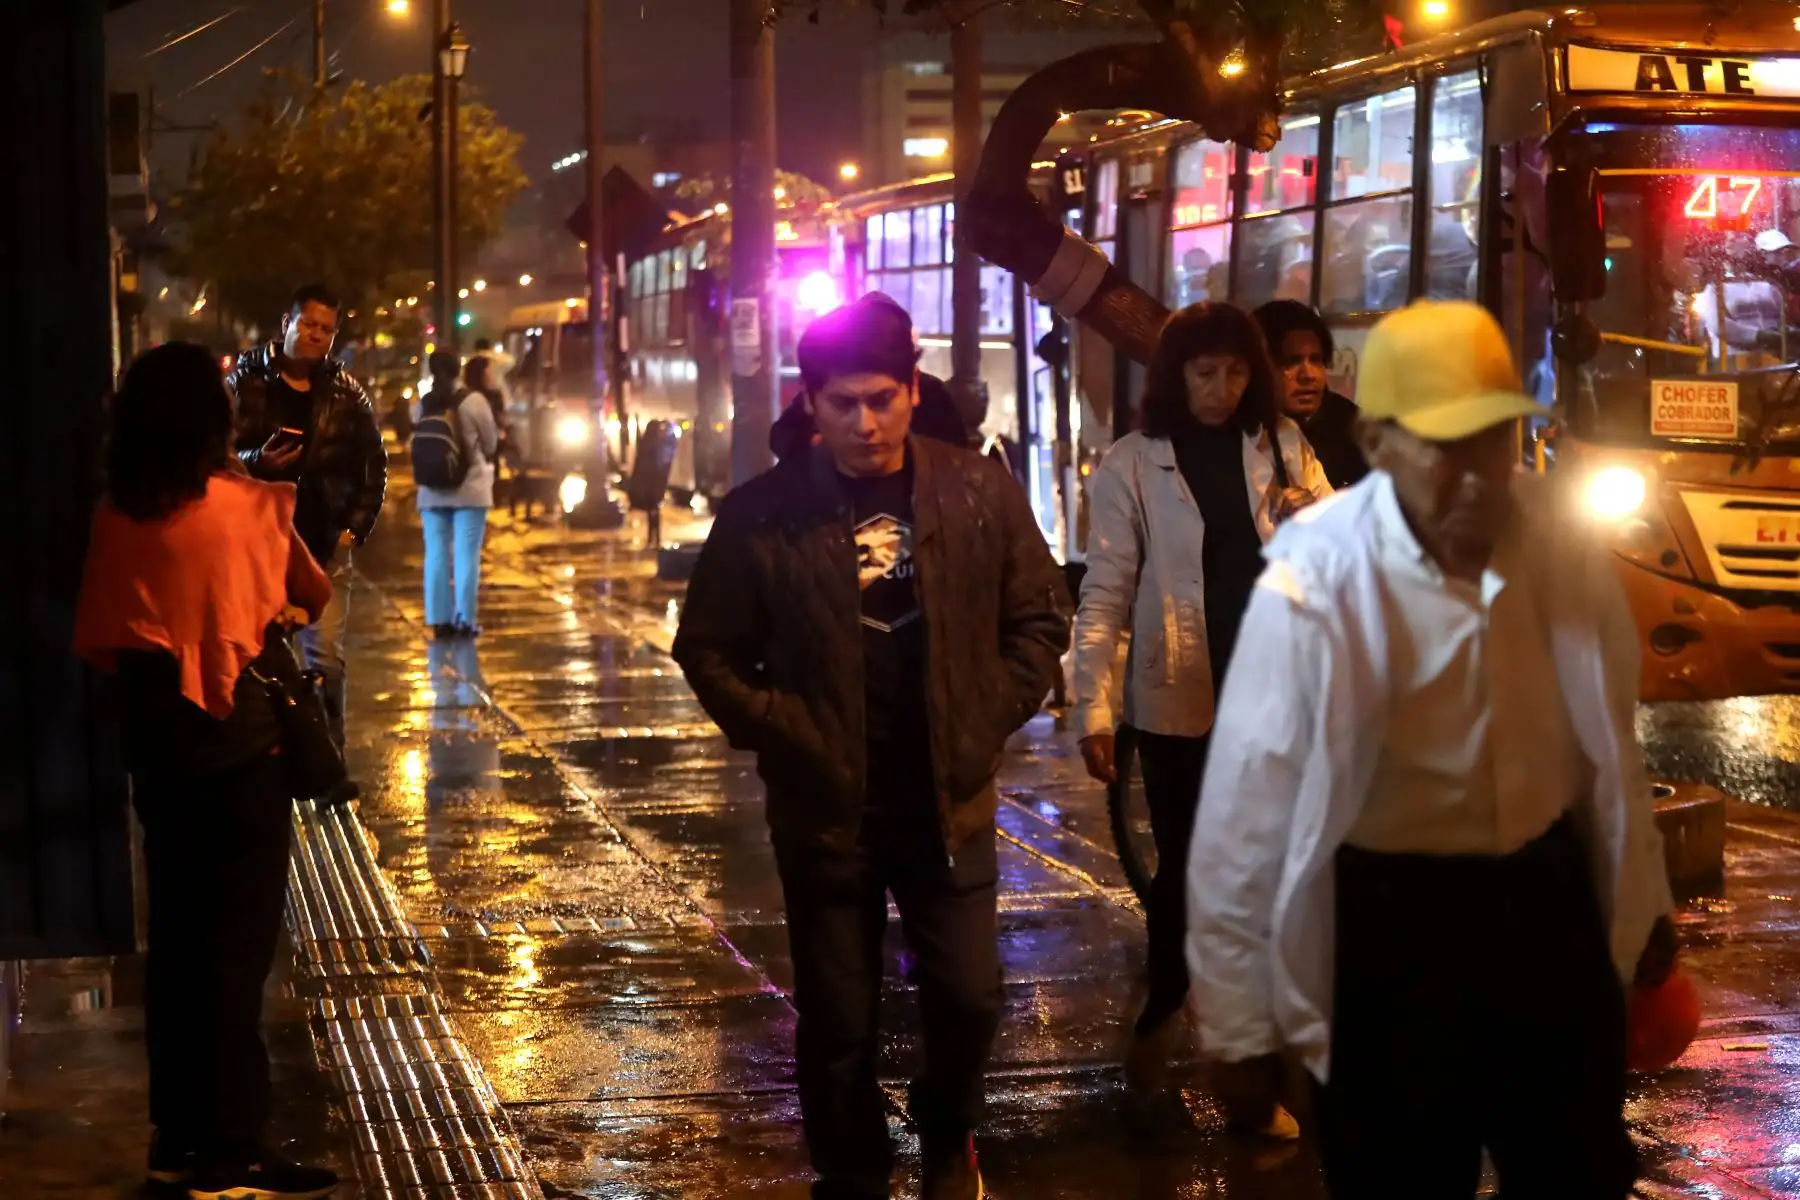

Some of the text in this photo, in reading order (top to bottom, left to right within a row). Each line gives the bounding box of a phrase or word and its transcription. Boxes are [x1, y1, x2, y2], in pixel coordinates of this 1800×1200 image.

[1634, 55, 1755, 96] ATE
[1684, 175, 1761, 218] 47
[1661, 386, 1729, 404] CHOFER
[1658, 404, 1731, 421] COBRADOR
